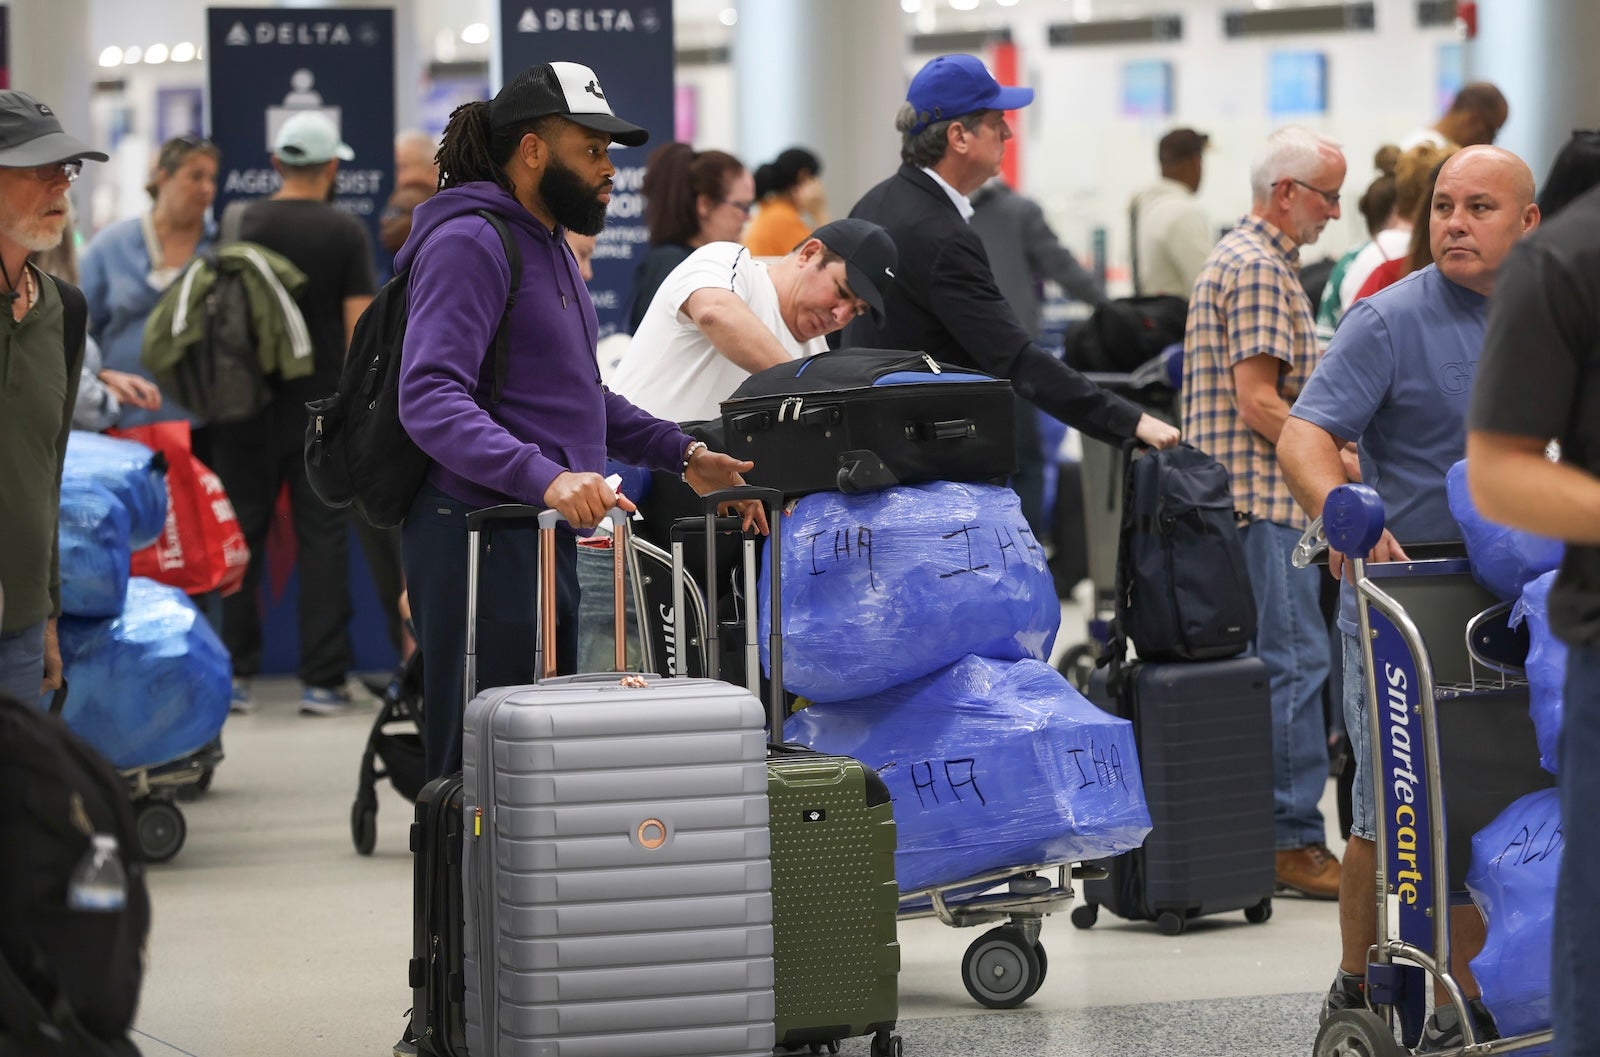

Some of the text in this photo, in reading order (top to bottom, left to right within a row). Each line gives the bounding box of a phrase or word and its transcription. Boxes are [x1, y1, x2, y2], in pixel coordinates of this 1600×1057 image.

[545, 9, 634, 32] DELTA
[255, 21, 351, 45] DELTA
[224, 168, 283, 194] AGEN
